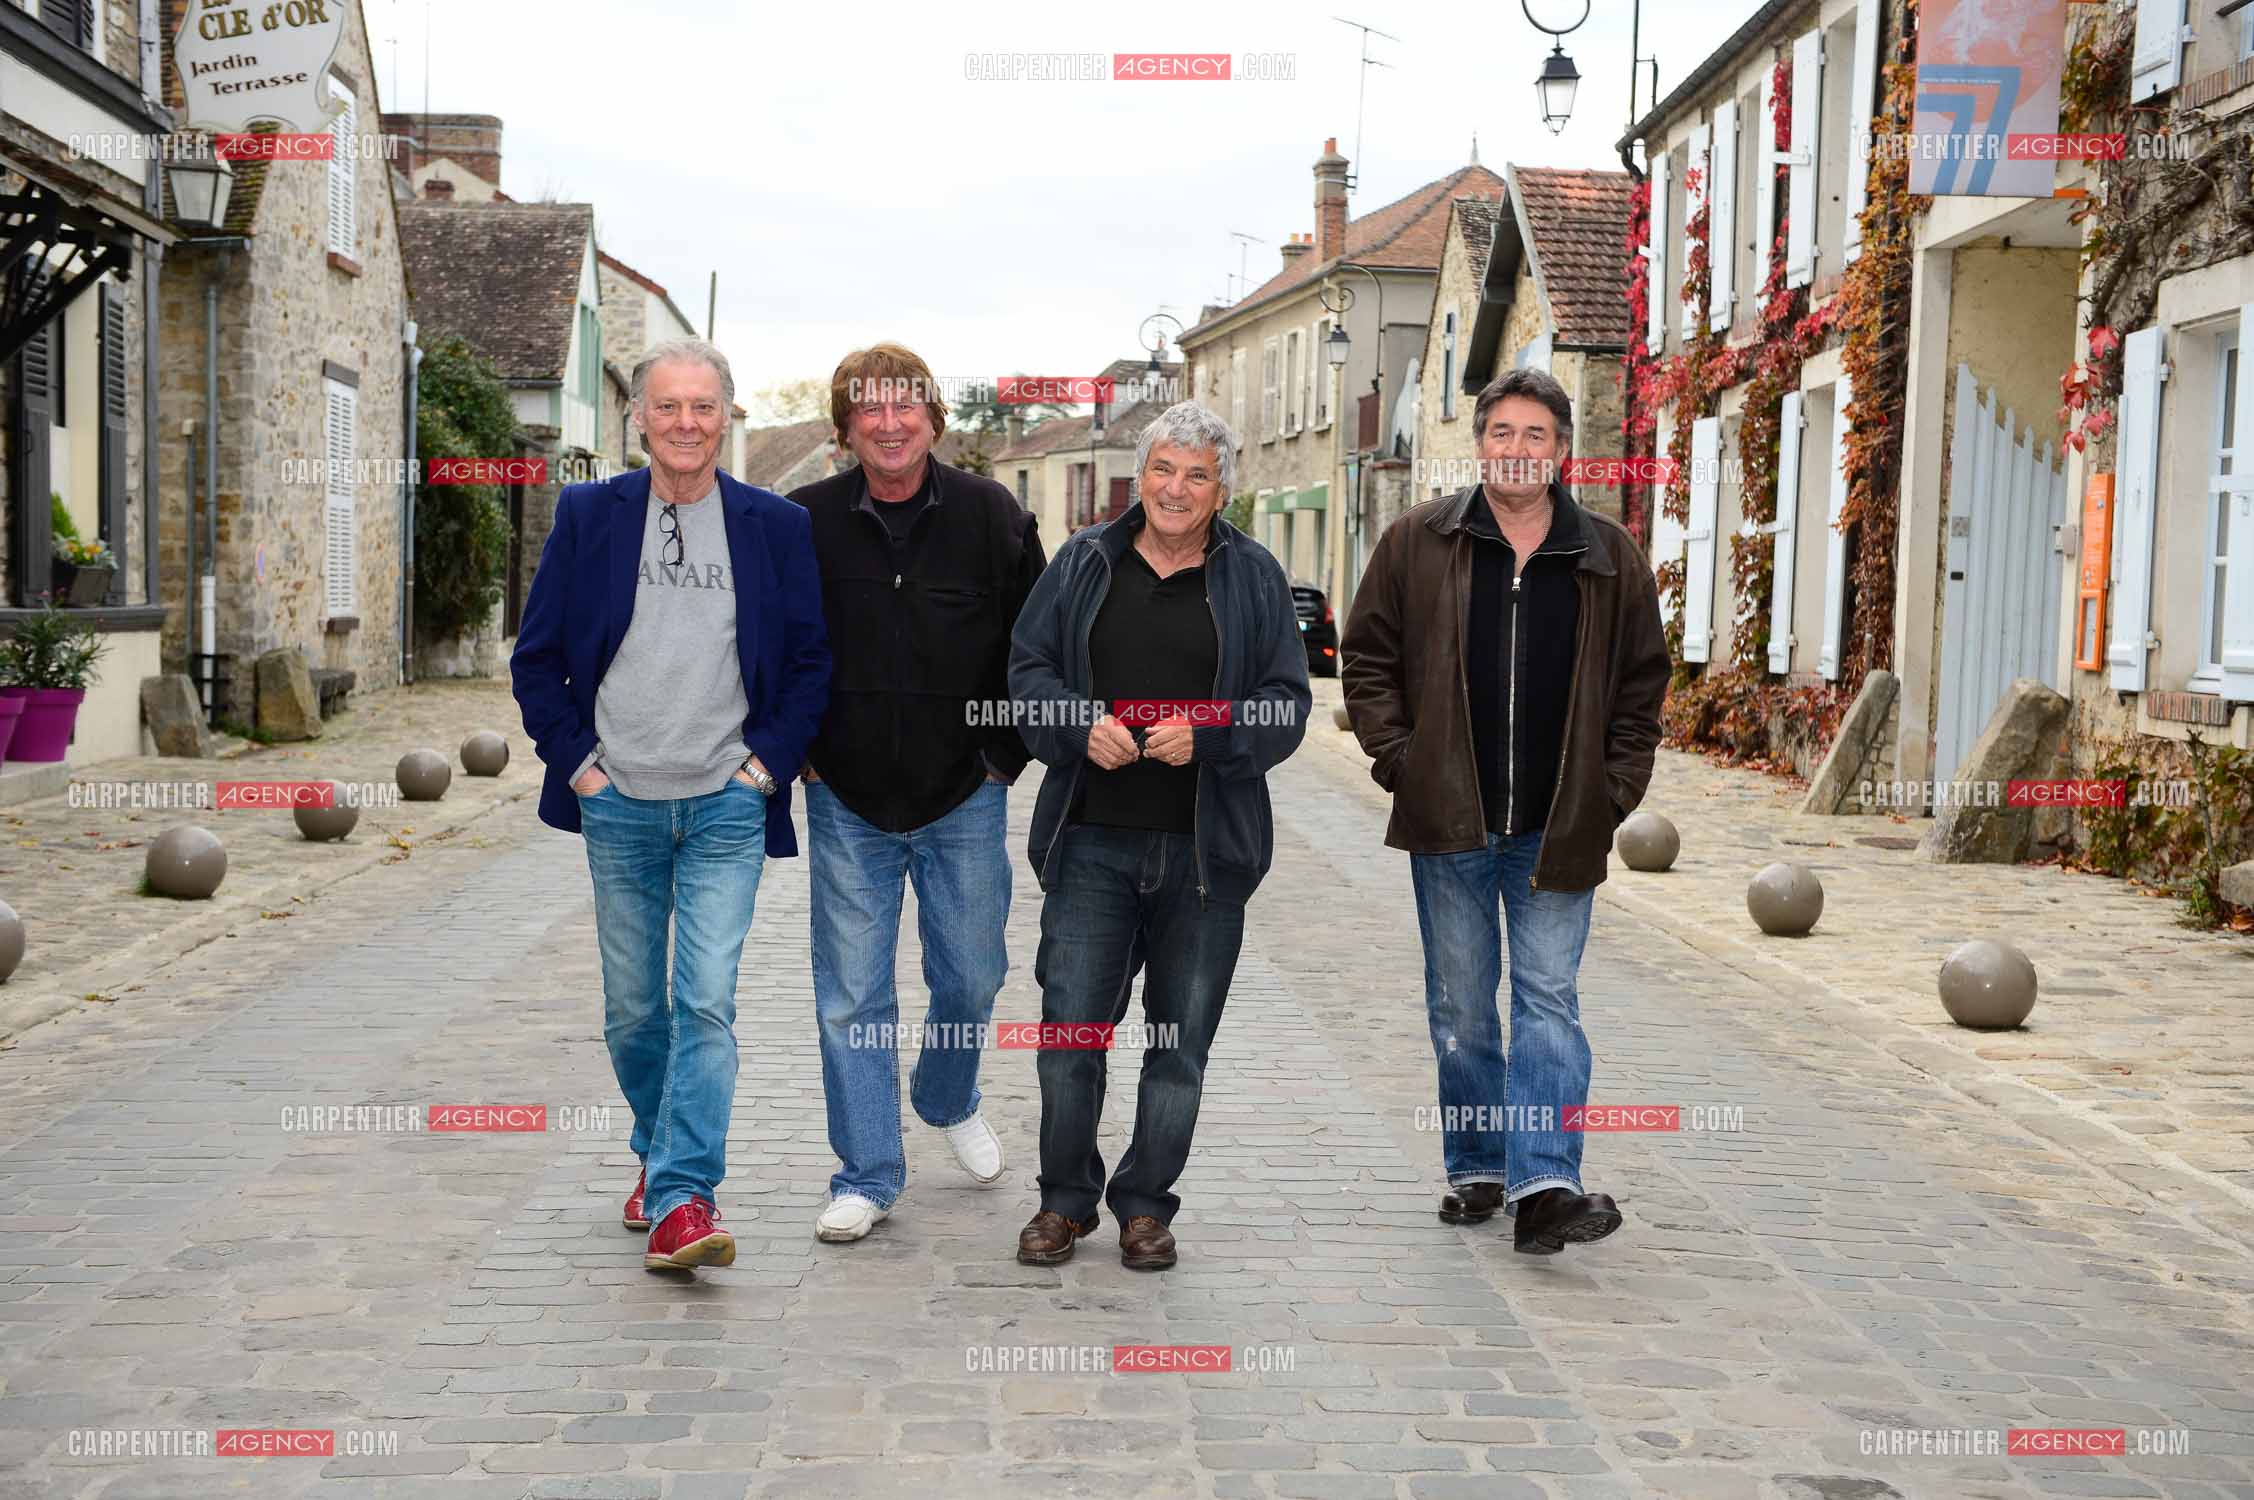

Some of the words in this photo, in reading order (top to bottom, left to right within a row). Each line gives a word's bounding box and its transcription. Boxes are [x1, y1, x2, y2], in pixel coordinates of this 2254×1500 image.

[198, 8, 253, 41] CLE
[261, 0, 330, 32] d'OR
[191, 53, 257, 78] Jardin
[208, 71, 308, 96] Terrasse
[637, 559, 735, 593] ANAR
